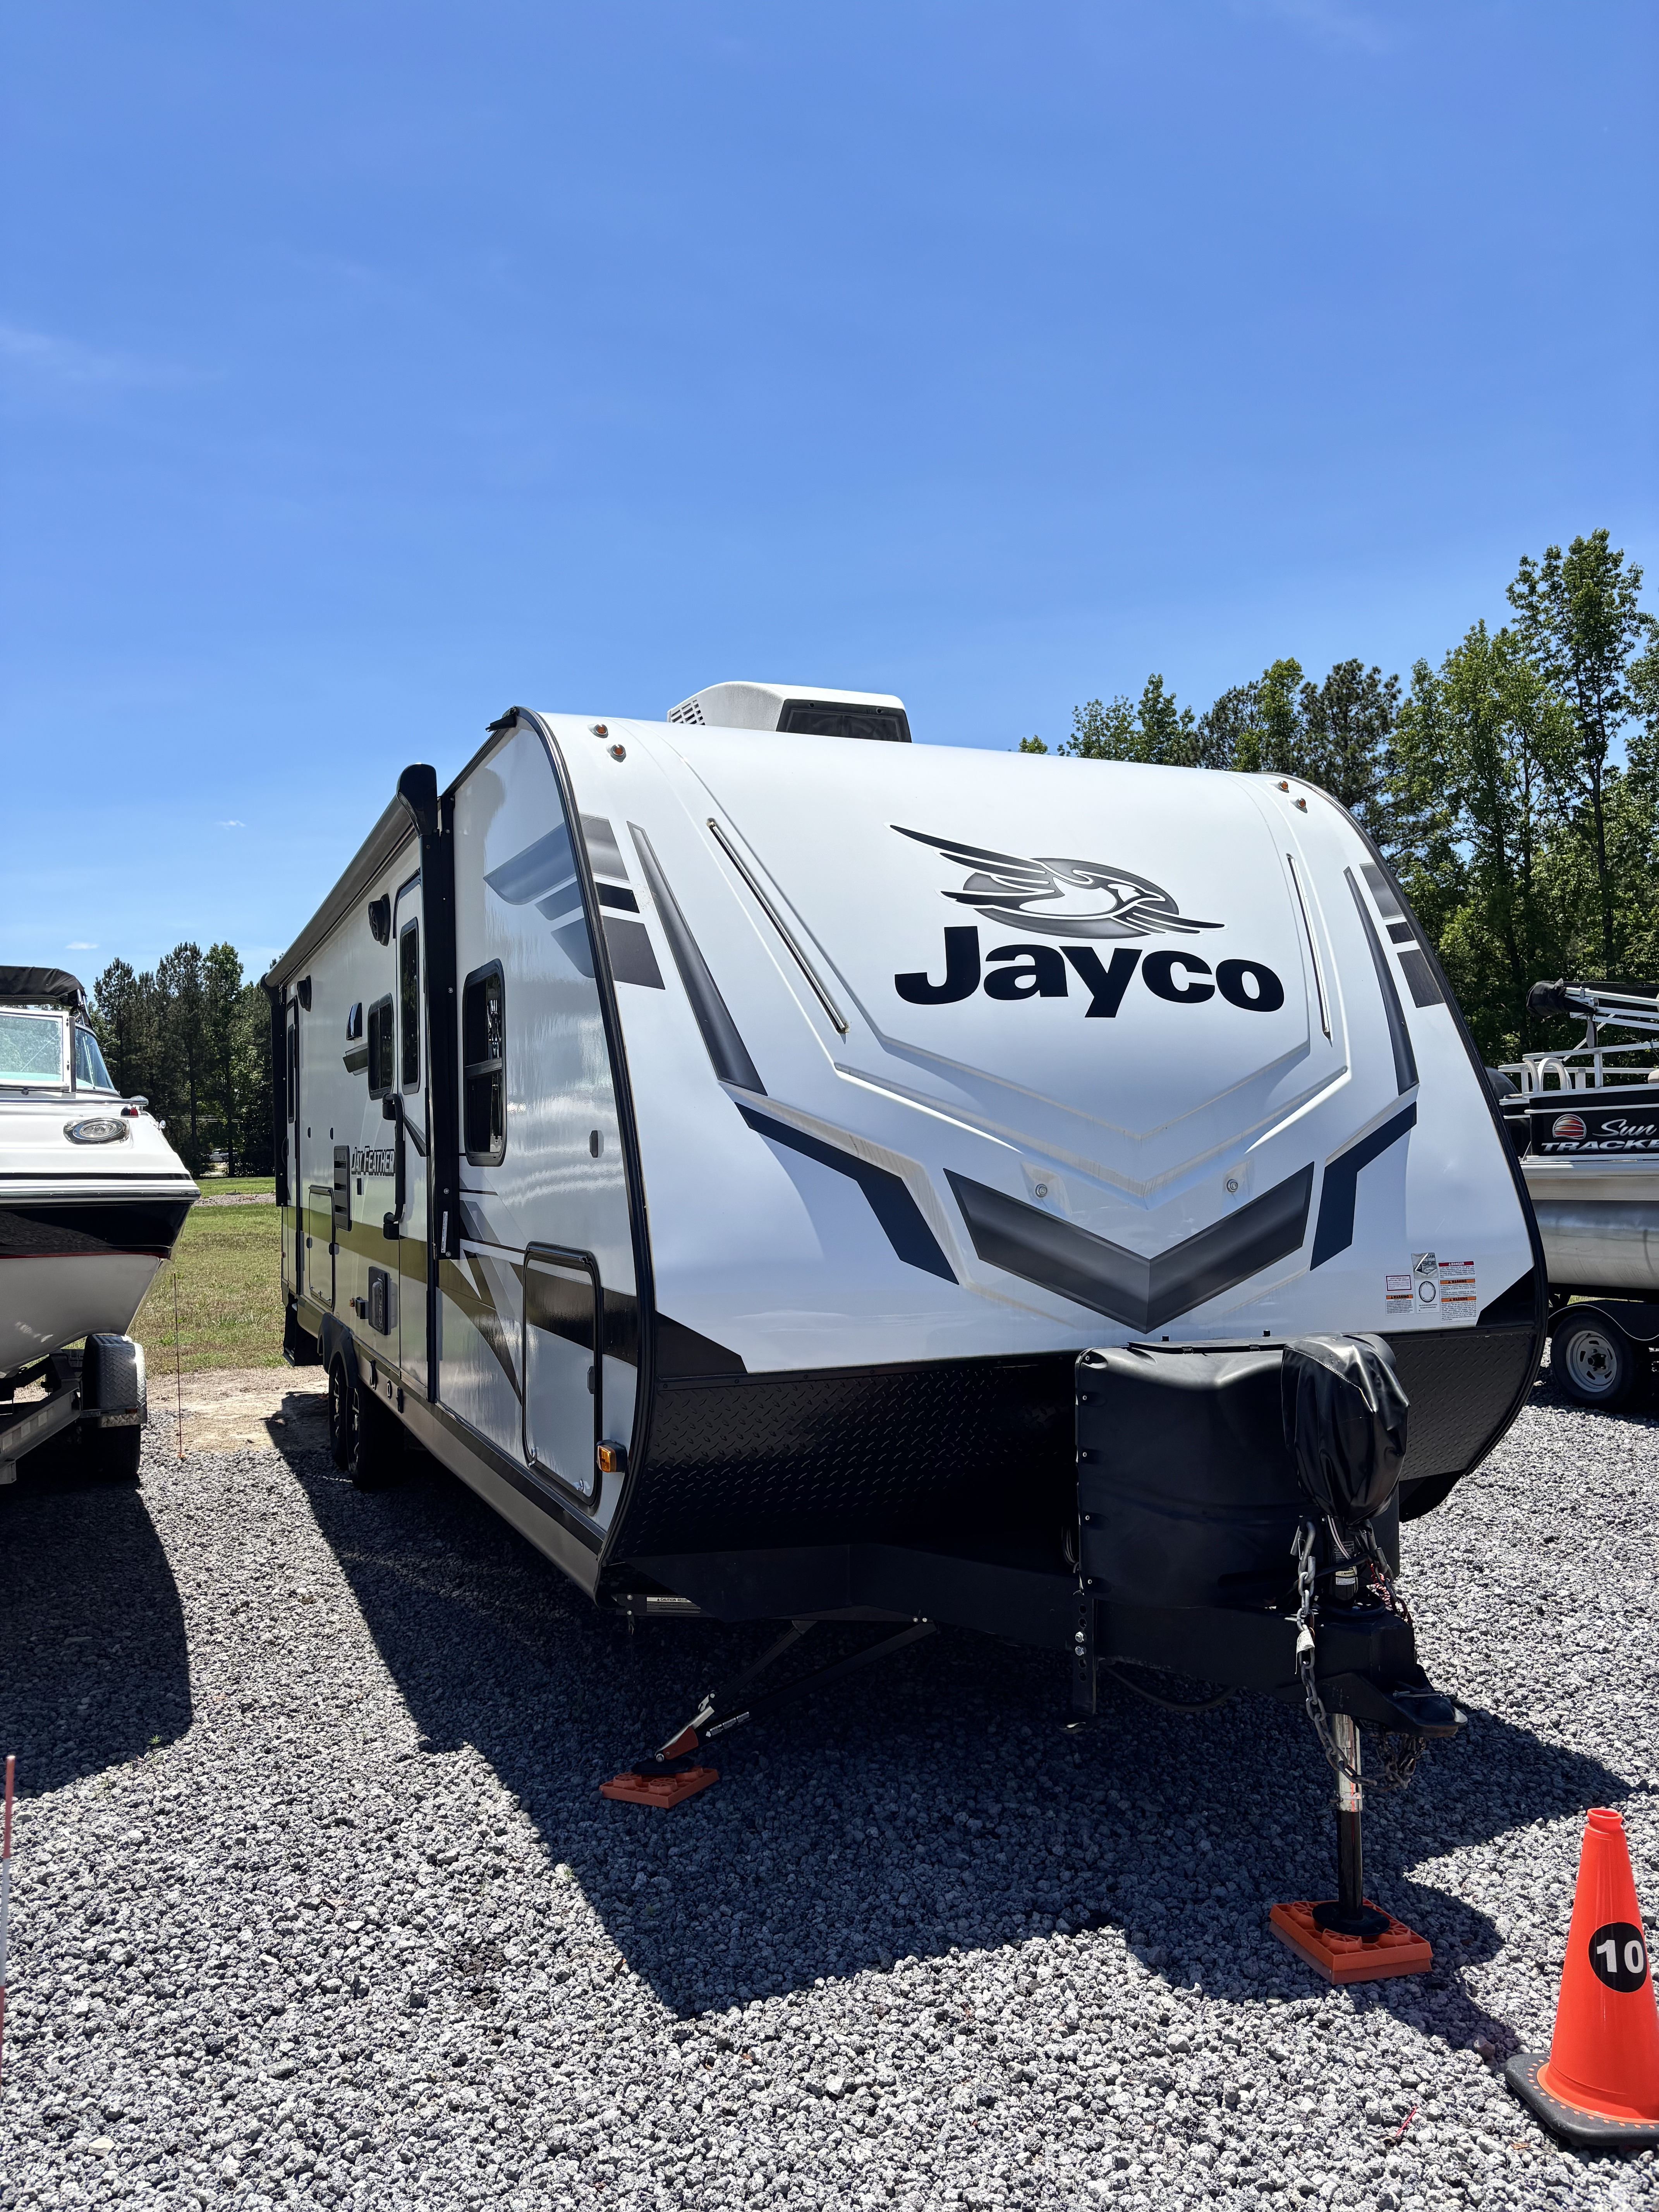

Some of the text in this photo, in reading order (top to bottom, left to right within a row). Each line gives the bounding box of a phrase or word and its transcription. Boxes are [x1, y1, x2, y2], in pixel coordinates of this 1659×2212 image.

[895, 926, 1285, 1017] Jayco
[1592, 1119, 1657, 1137] Sun
[1597, 1940, 1644, 1973] 10
